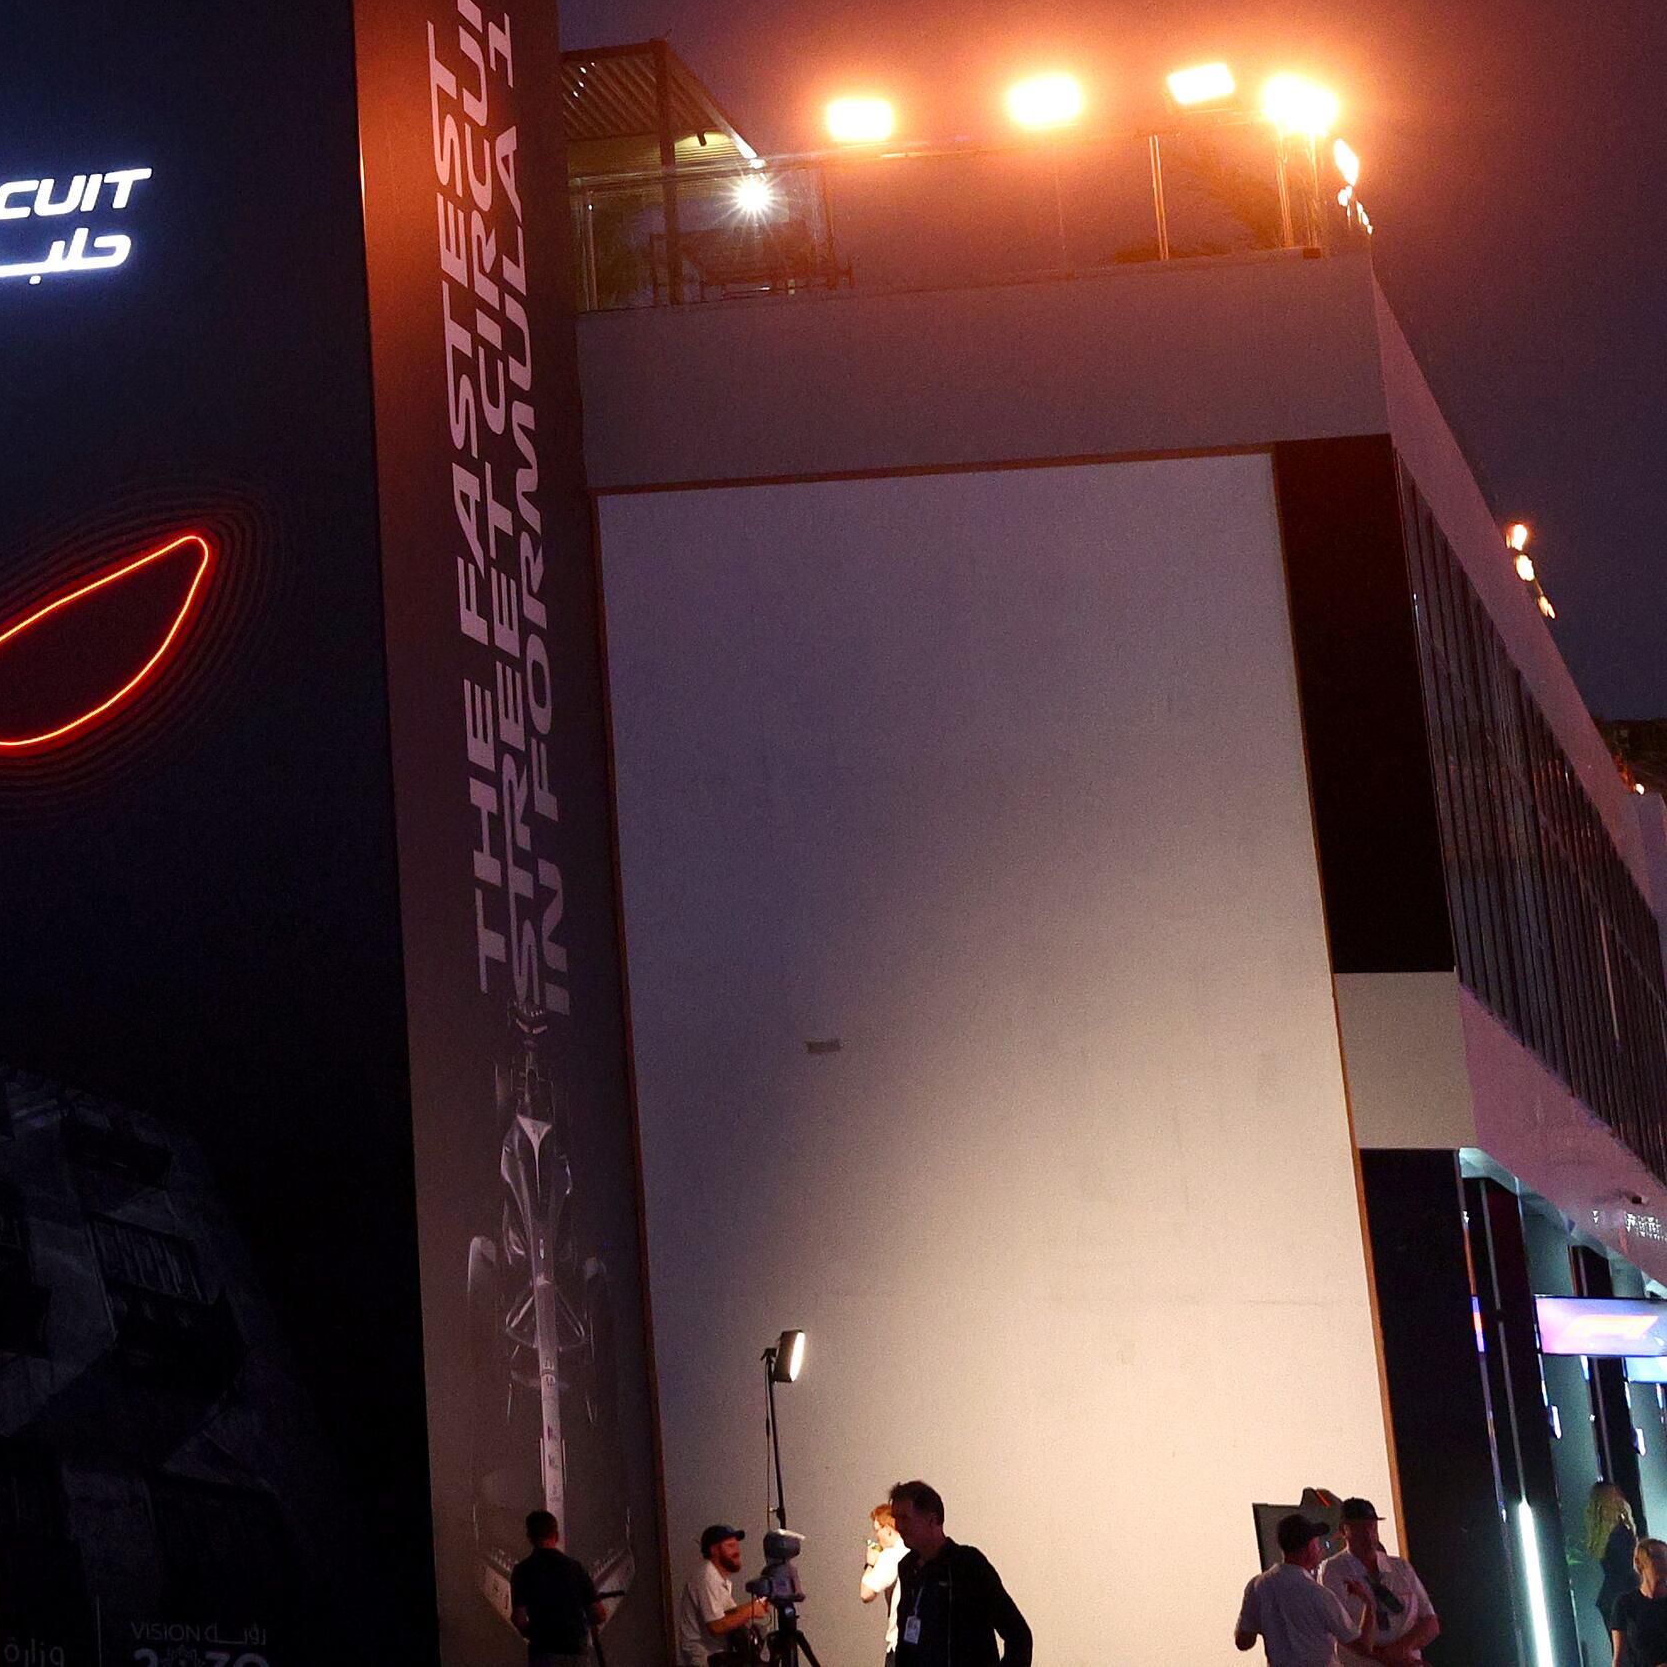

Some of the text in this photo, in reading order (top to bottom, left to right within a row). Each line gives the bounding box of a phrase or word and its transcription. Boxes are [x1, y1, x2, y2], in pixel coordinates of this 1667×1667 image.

[427, 20, 509, 995] THE FASTEST
[485, 460, 540, 1006] STREET
[496, 126, 559, 823] FORMULA
[537, 857, 571, 1017] IN
[130, 1622, 201, 1643] VISION
